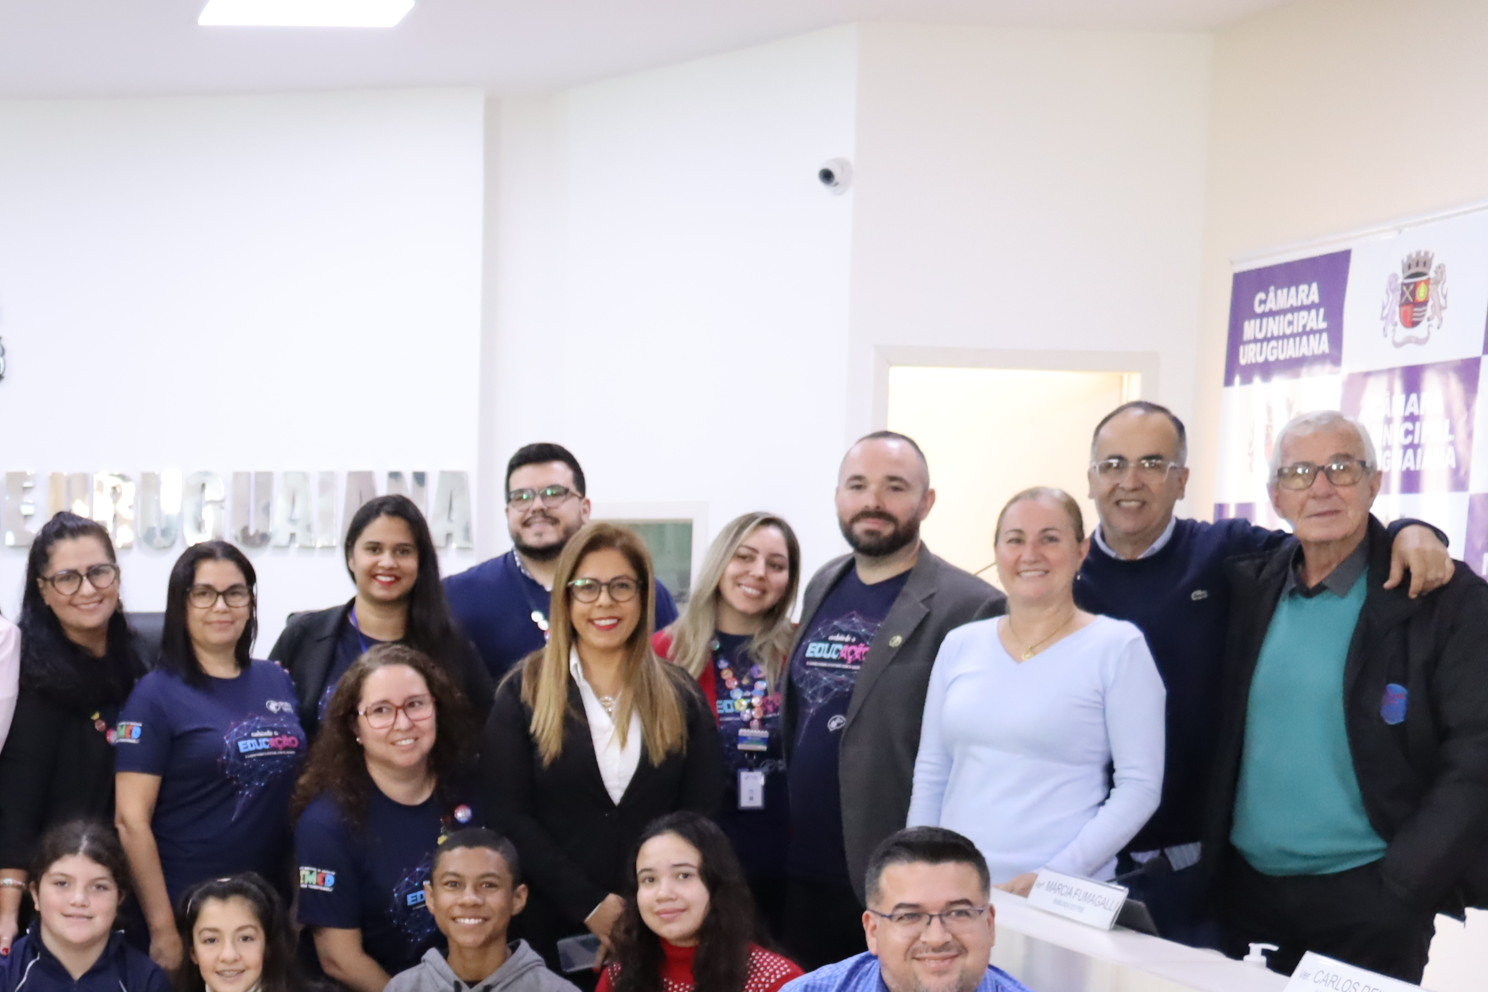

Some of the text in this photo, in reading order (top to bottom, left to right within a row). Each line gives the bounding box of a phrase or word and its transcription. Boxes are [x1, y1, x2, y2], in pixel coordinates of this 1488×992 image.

[1253, 281, 1320, 314] CÂMARA
[1242, 308, 1328, 341] MUNICIPAL
[1238, 332, 1330, 366] URUGUAIANA
[49, 470, 473, 551] URUGUAIAA
[805, 642, 870, 664] EDUCAÇÃ
